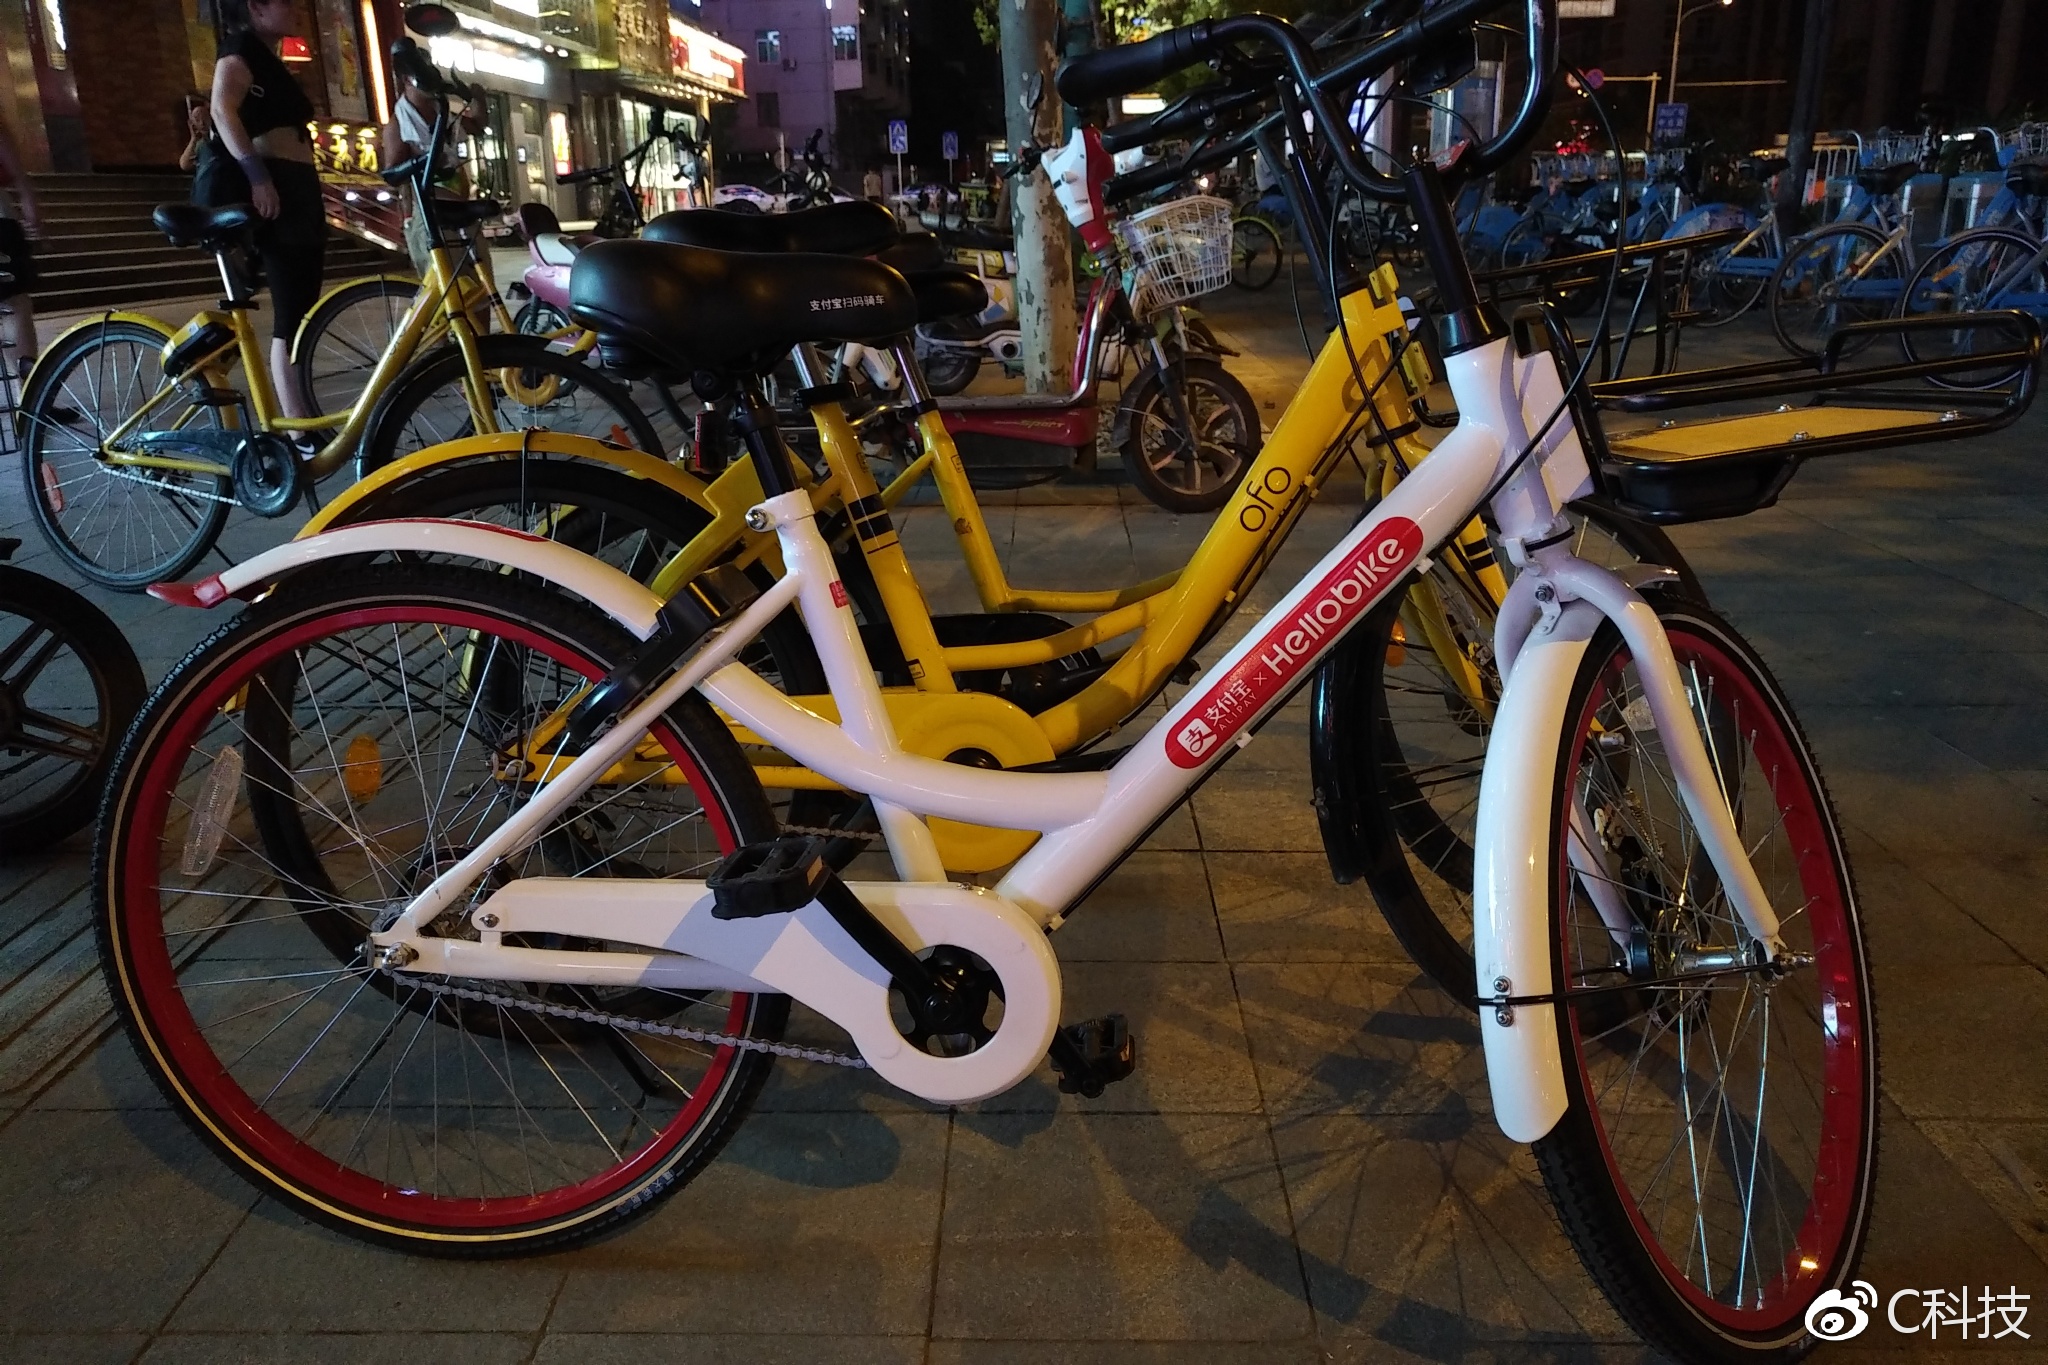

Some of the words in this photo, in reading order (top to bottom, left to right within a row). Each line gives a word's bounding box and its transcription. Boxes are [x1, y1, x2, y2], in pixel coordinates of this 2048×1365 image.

[809, 294, 885, 311] 支付宝扫码骑车
[1240, 466, 1291, 532] ofo
[1204, 679, 1252, 727] 支付宝
[1261, 538, 1404, 676] Hellobike
[1219, 692, 1257, 731] ALIPAY
